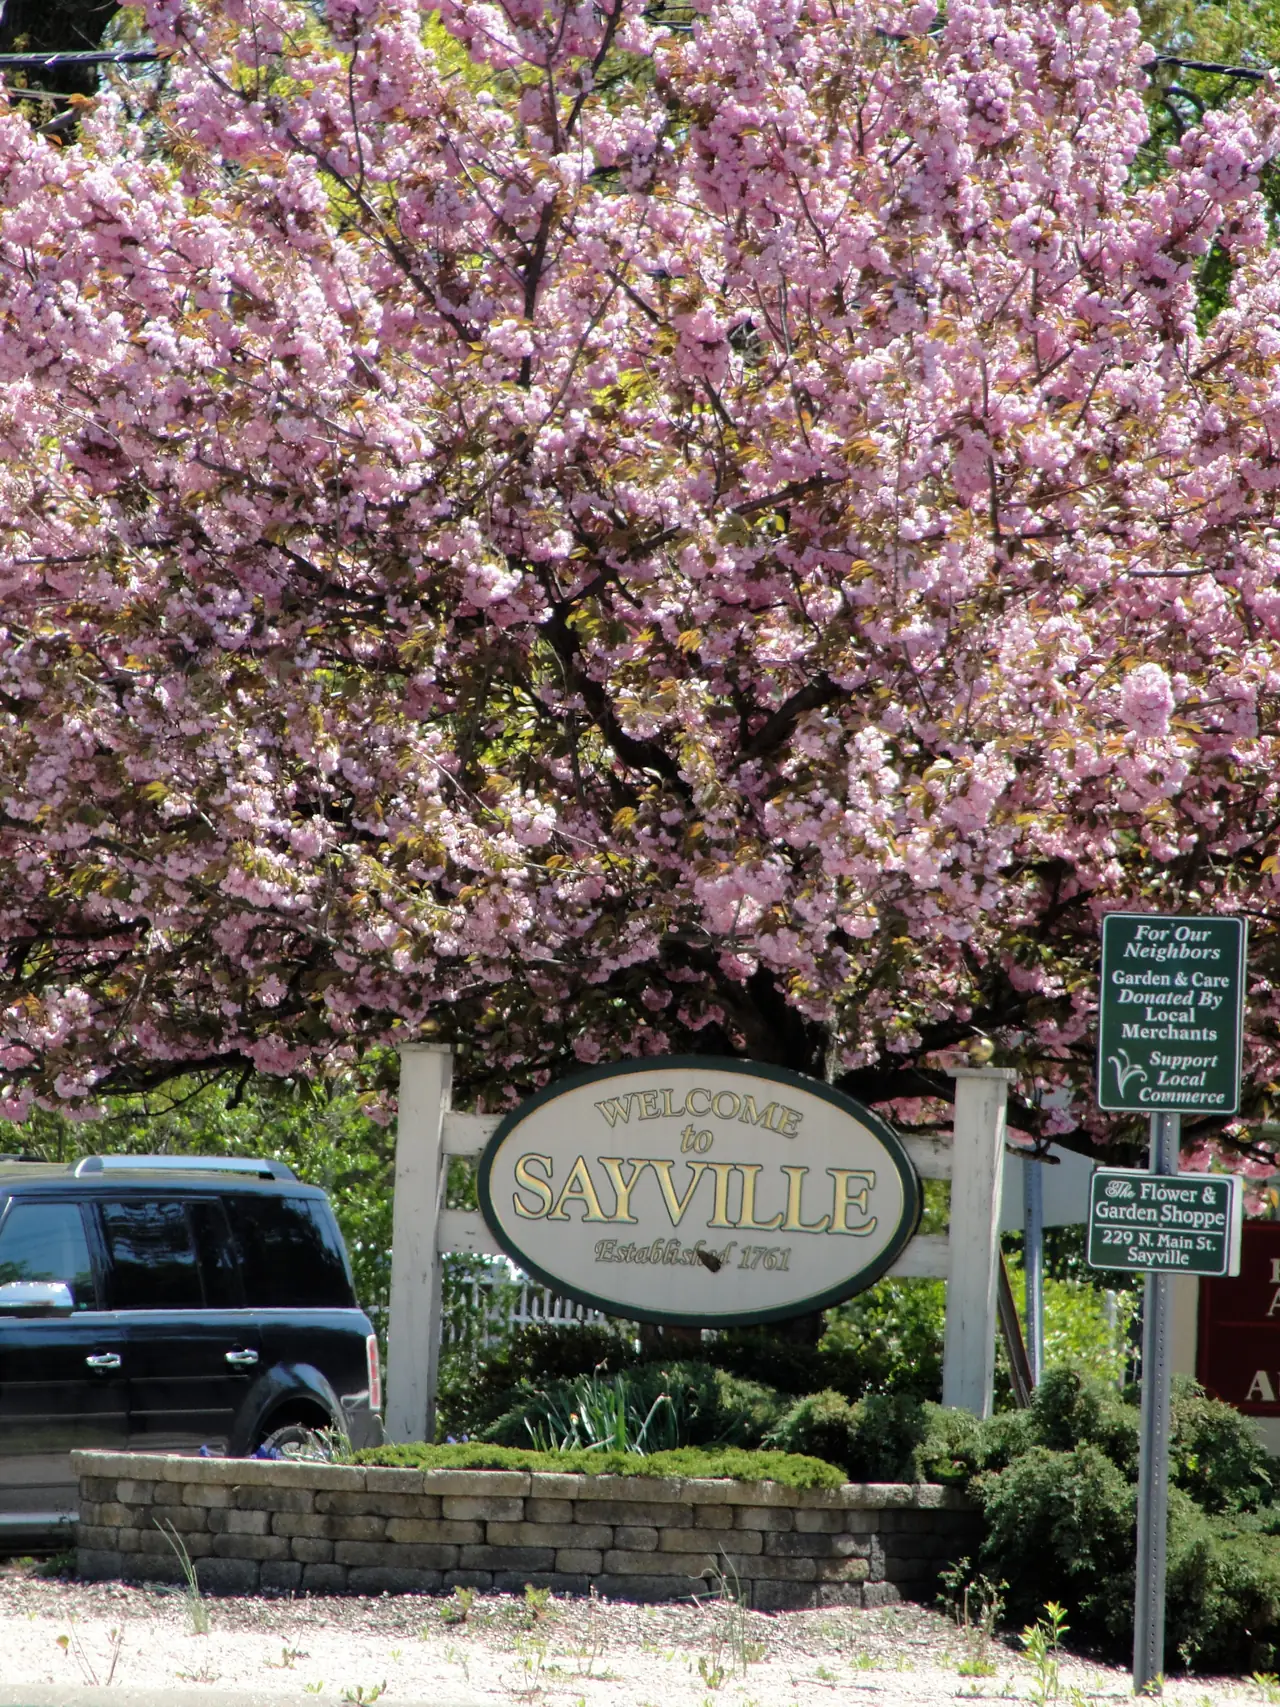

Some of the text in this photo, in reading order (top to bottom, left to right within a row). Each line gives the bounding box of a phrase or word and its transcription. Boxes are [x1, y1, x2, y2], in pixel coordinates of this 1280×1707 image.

[1134, 924, 1212, 942] For Our
[1123, 942, 1221, 962] Neighbors
[1112, 969, 1230, 987] Garden & Care
[1118, 988, 1223, 1010] Donated By
[1145, 1006, 1196, 1023] Local
[1121, 1023, 1218, 1041] Merchants
[1149, 1050, 1219, 1070] Support
[1157, 1071, 1206, 1086] Local
[1138, 1087, 1225, 1104] Commerce
[594, 1088, 804, 1139] WELCOME
[679, 1124, 714, 1154] to
[512, 1152, 878, 1236] SAYVILLE
[1104, 1180, 1217, 1205] The Flower &
[1095, 1201, 1225, 1229] Garden Shoppe
[1102, 1229, 1217, 1251] 229 N. Main St.
[737, 1246, 791, 1271] 1761
[1127, 1246, 1190, 1266] Sayville
